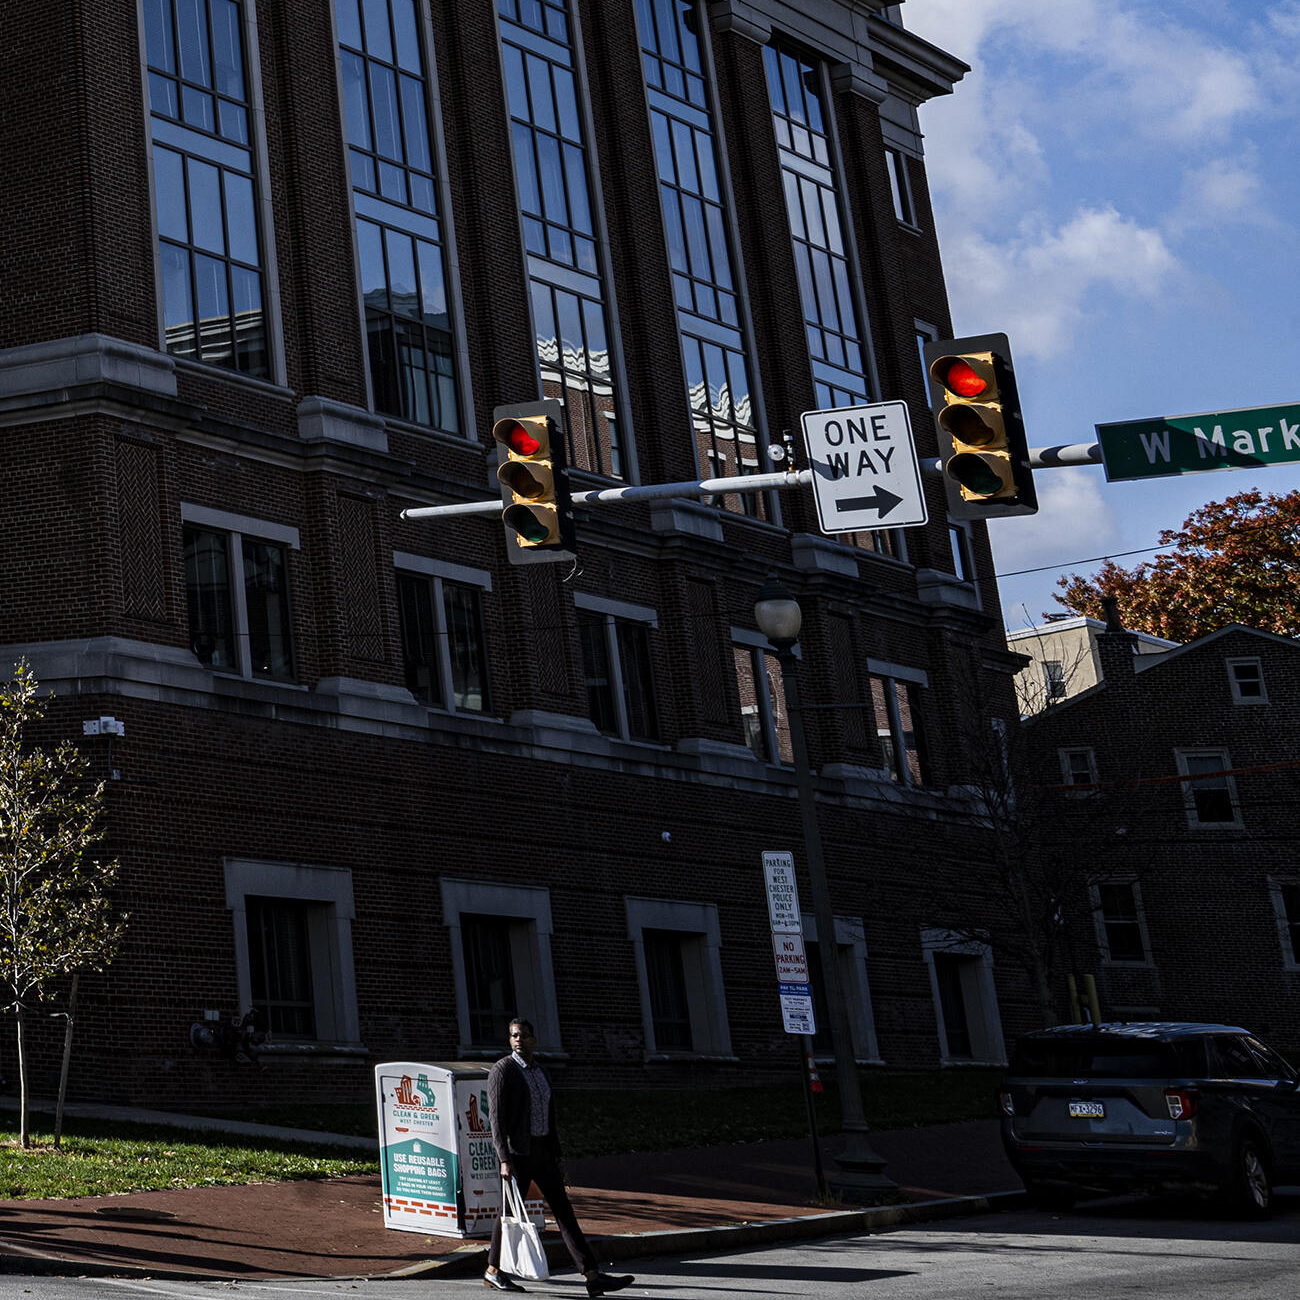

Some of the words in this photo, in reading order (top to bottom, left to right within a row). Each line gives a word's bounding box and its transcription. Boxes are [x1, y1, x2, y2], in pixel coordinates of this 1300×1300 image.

[824, 414, 891, 446] ONE
[1139, 431, 1171, 464] W
[1193, 418, 1300, 459] Mark
[826, 446, 895, 479] WAY
[766, 858, 791, 868] PARKING
[769, 884, 794, 892] CHESTER
[772, 894, 792, 902] POLICE
[775, 902, 792, 910] ONLY
[783, 941, 794, 952] NO
[776, 954, 805, 964] PARKING
[393, 1110, 411, 1118] CLEAN
[469, 1142, 492, 1156] CLEAN
[394, 1153, 407, 1163] USE
[409, 1155, 445, 1167] REUSABLE
[472, 1157, 496, 1171] GREEN
[393, 1163, 426, 1175] SHOPPING
[427, 1167, 447, 1178] BAGS
